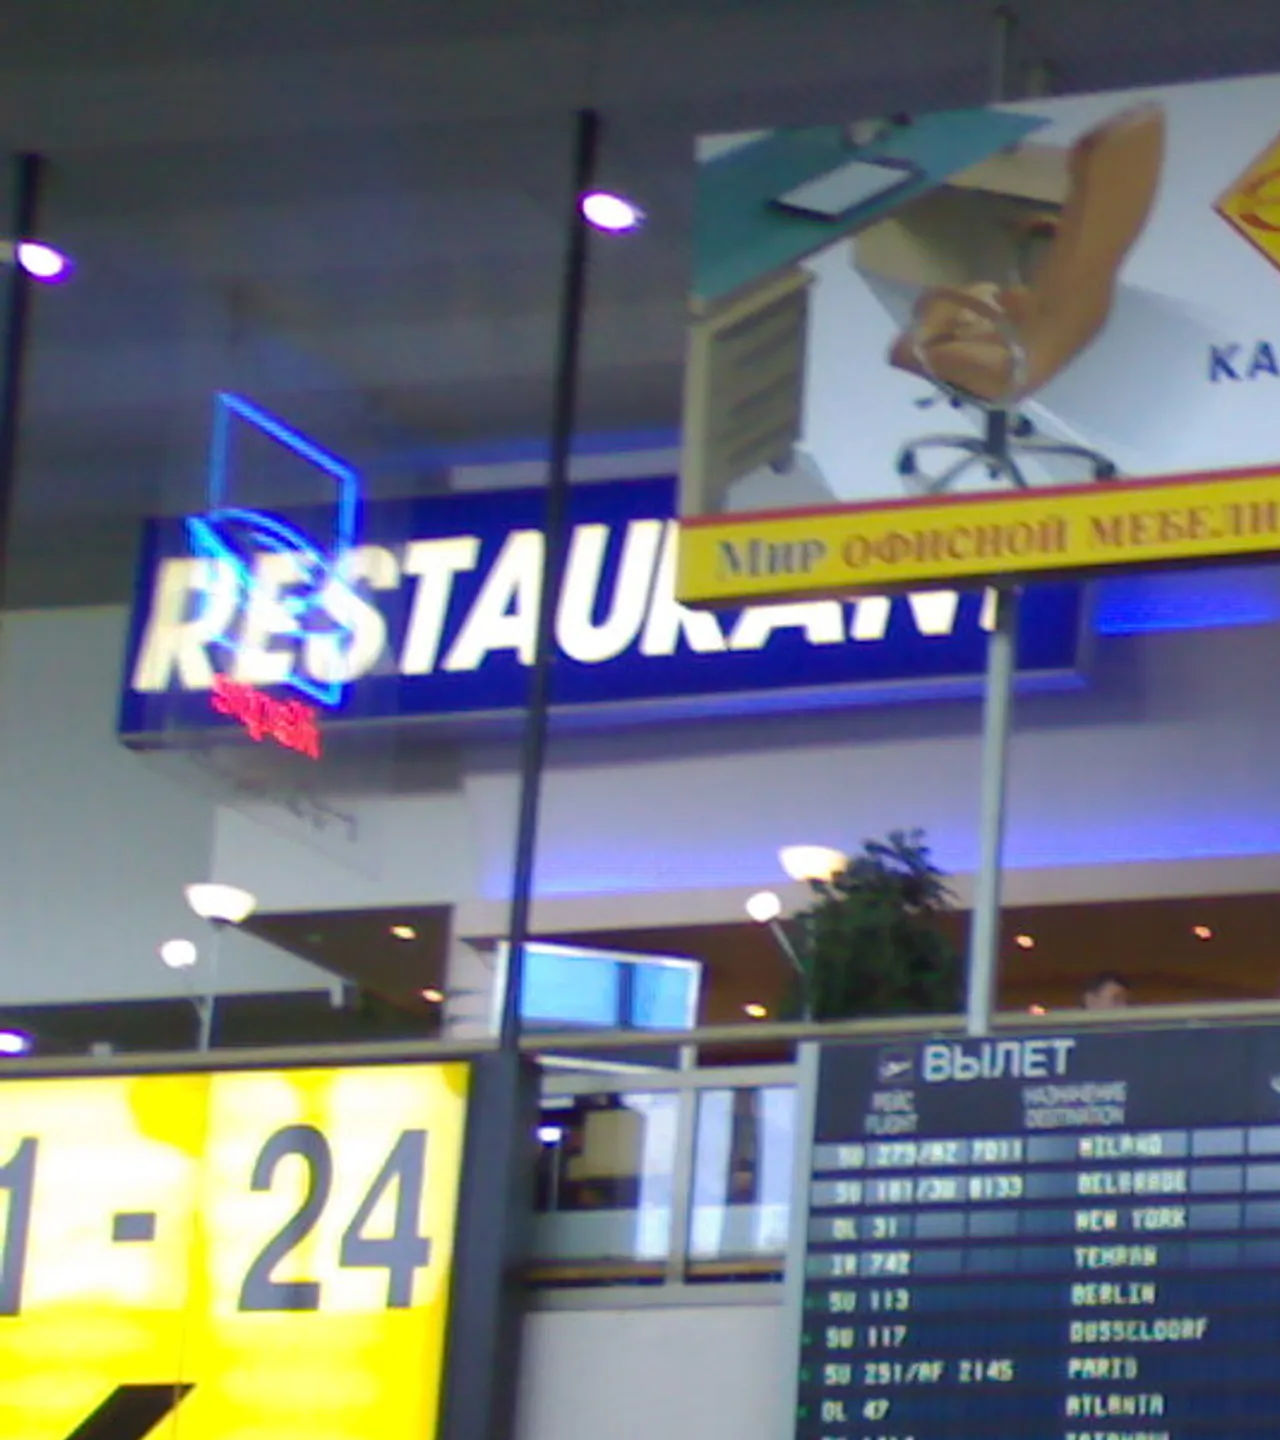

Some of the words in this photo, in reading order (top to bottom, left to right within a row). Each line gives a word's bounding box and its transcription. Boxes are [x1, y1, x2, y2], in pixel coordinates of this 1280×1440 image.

[841, 511, 1069, 570] ОФИСНОЙ
[1087, 500, 1280, 551] МЕБЕЛИ
[922, 1039, 1076, 1082] ВЫЛЕТ
[237, 1124, 431, 1312] 24
[1131, 1207, 1187, 1230] YORK
